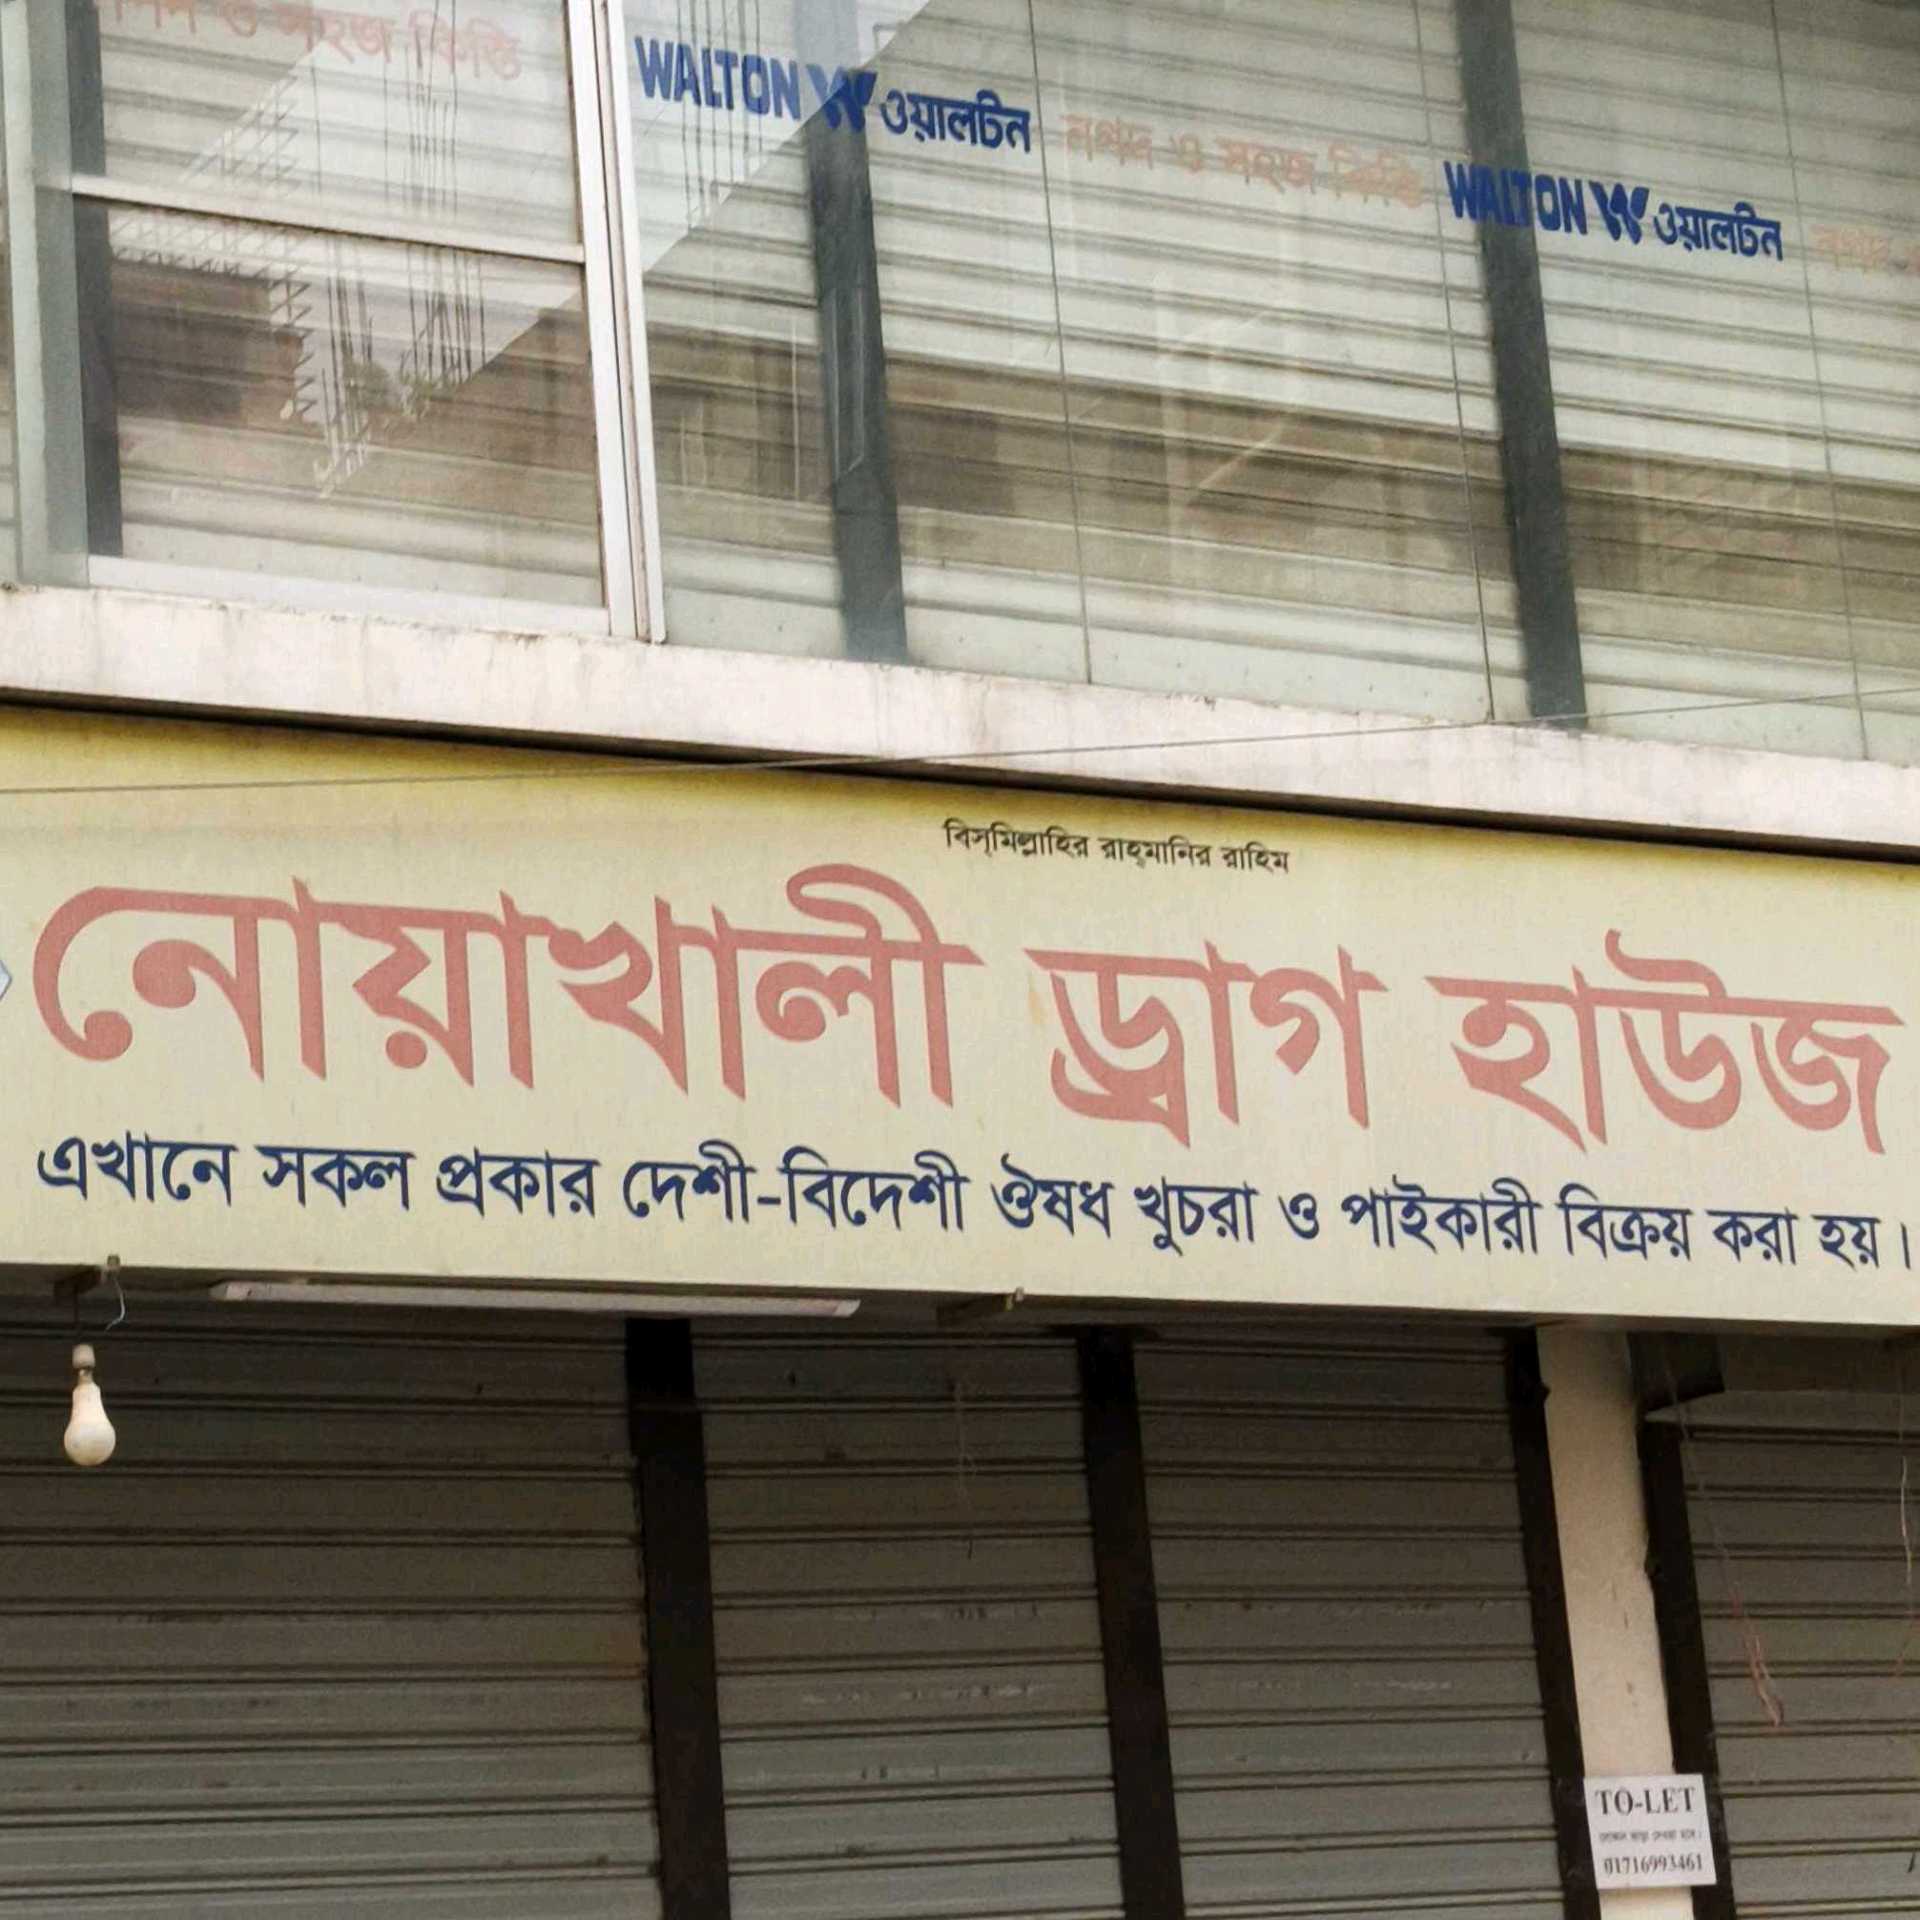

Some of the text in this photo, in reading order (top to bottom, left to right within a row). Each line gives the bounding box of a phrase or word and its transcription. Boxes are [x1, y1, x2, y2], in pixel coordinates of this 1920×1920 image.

[633, 36, 801, 120] WALTON
[880, 88, 1031, 153] ওয়ালটন
[1443, 160, 1588, 236] WALTON
[1653, 202, 1783, 261] ওয়ালটন
[33, 863, 1905, 1154] নোয়াখালী ড্রাগ হাউজ
[37, 1130, 238, 1206] এখানে
[255, 1144, 416, 1210] সকল
[435, 1147, 601, 1219] প্রকার
[990, 1153, 1115, 1238] ঔষধ
[1134, 1176, 1259, 1256] খুচরা
[1278, 1191, 1320, 1241] ও
[1340, 1173, 1542, 1256] পাইকারী
[1555, 1182, 1692, 1261] বিক্রয়
[1705, 1207, 1799, 1266] করা
[1594, 1786, 1696, 1817] TO-LET
